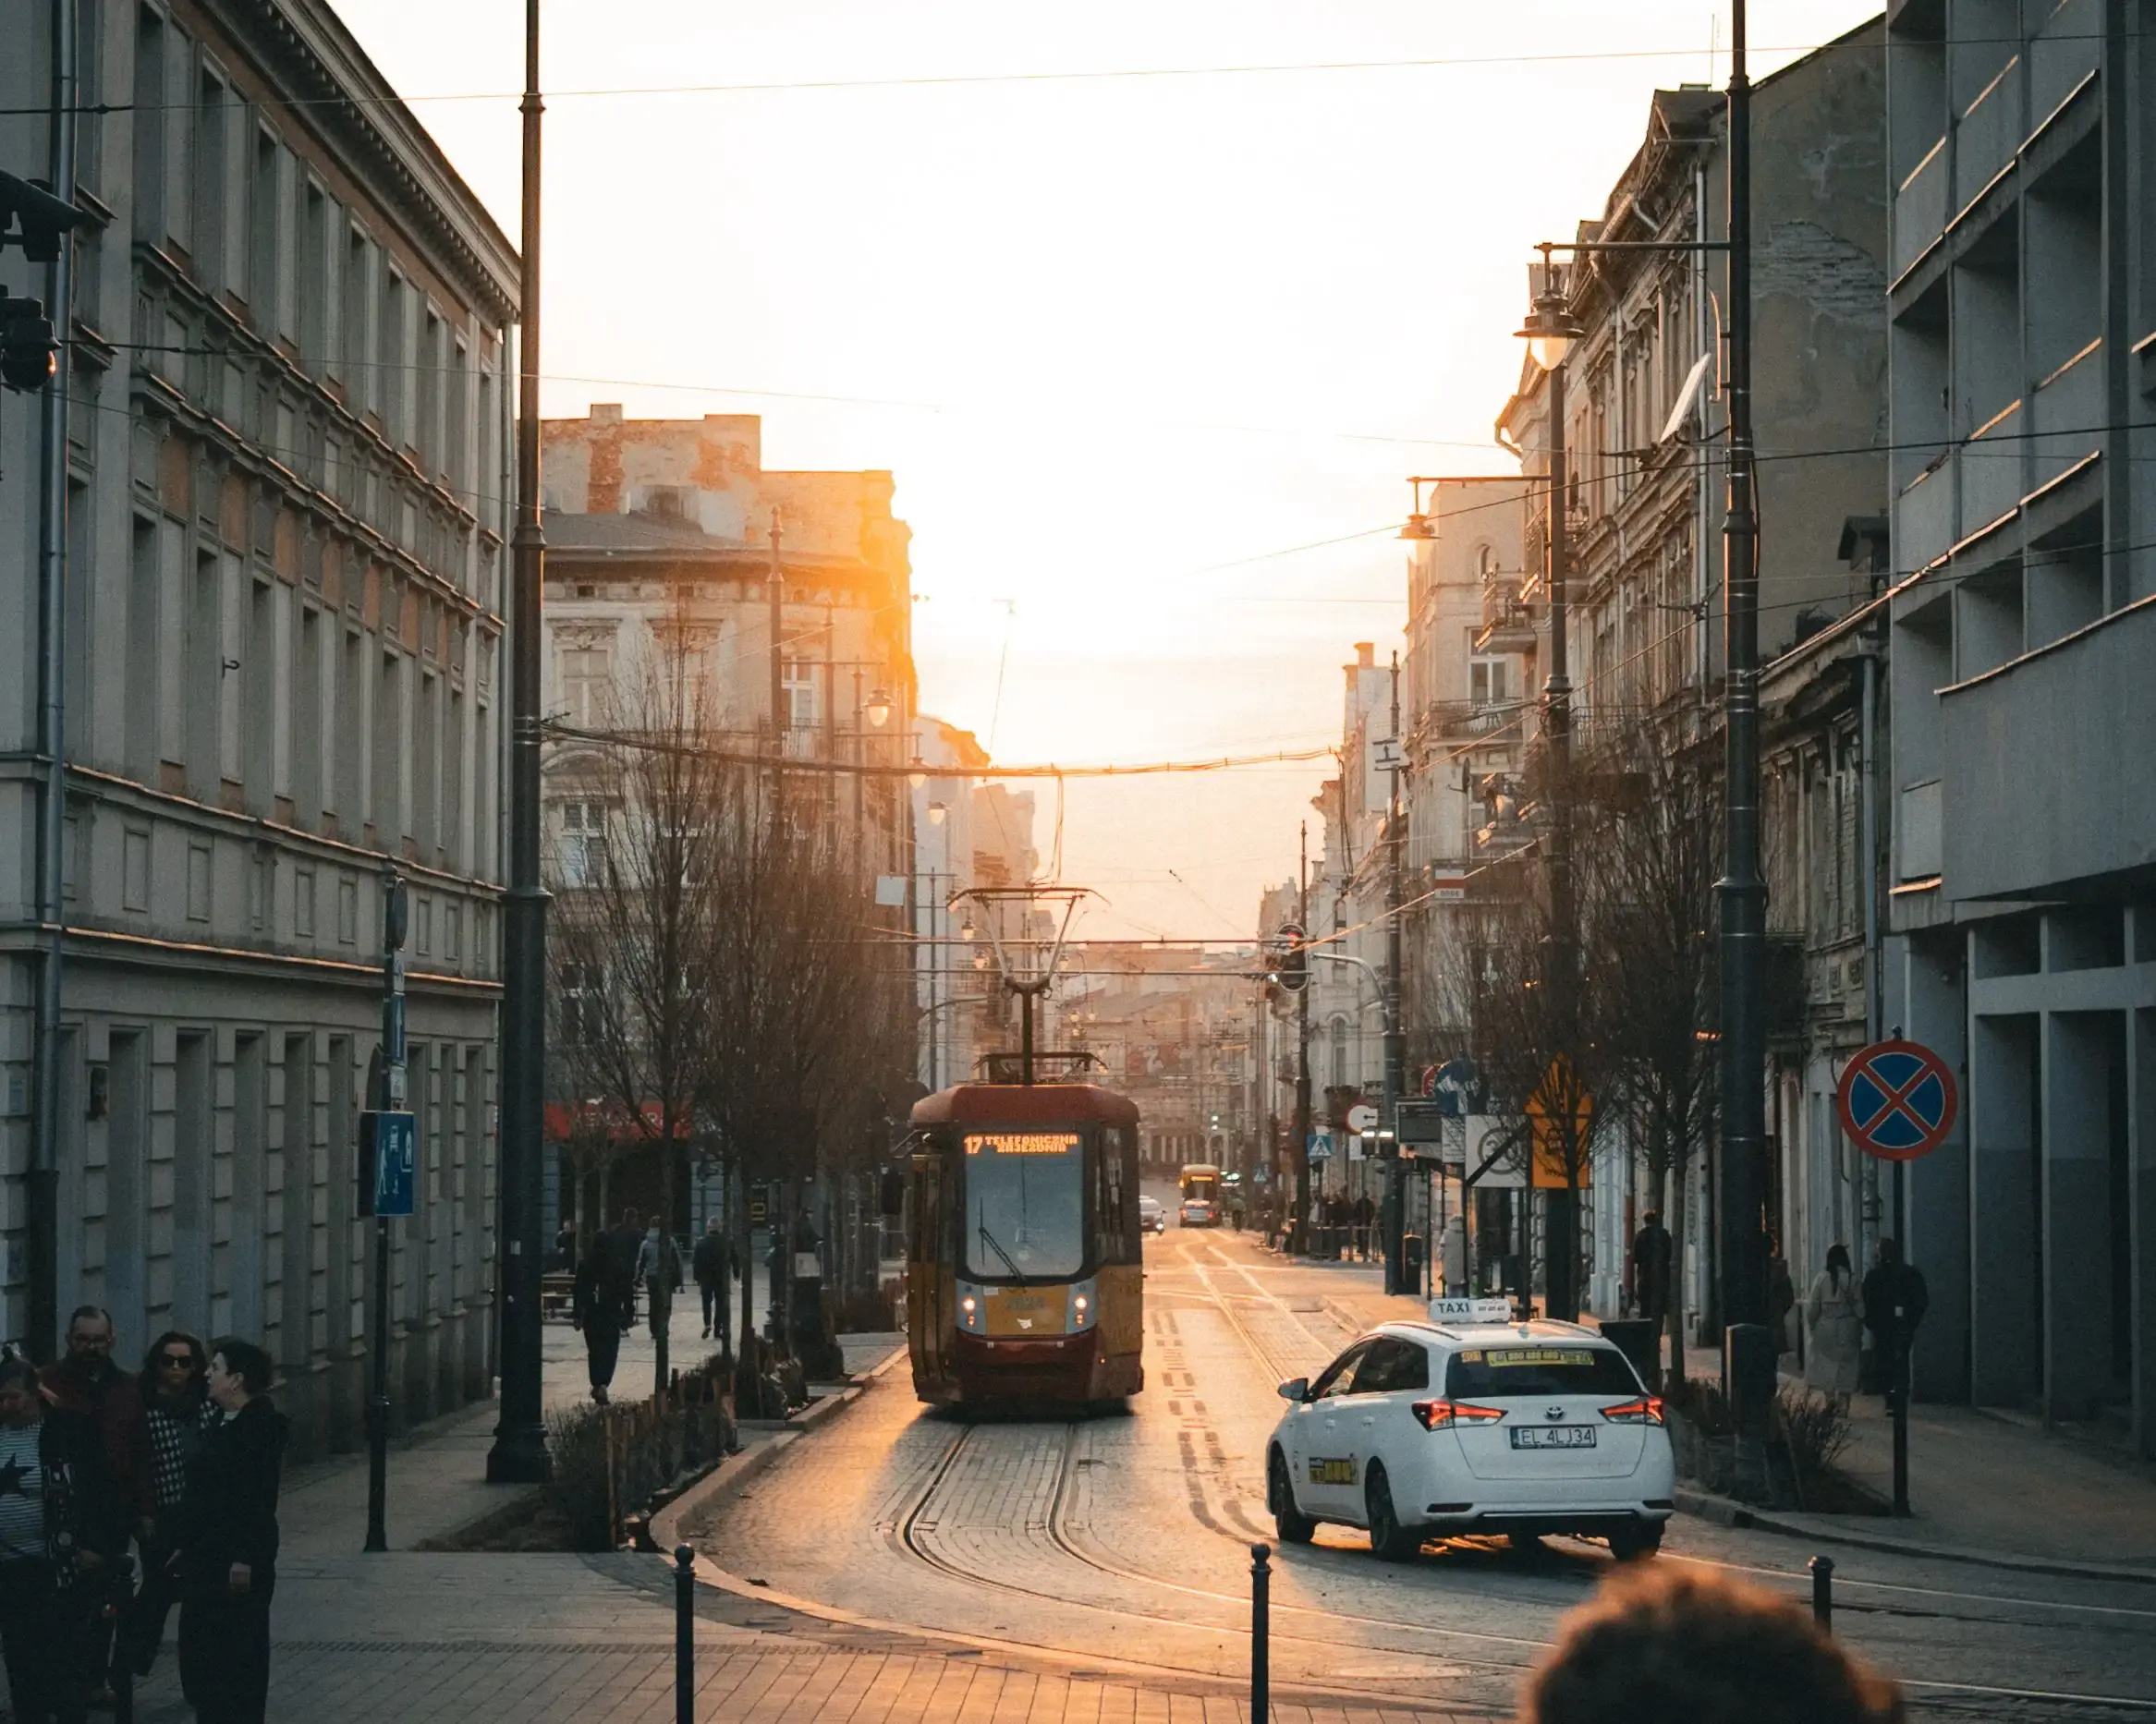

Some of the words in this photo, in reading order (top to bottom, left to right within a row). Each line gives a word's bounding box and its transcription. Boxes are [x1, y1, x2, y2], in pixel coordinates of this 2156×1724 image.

[964, 1135, 983, 1154] 17
[1437, 1303, 1470, 1314] TAXI
[1521, 1429, 1541, 1444] EL
[1547, 1428, 1591, 1443] 4LJ34
